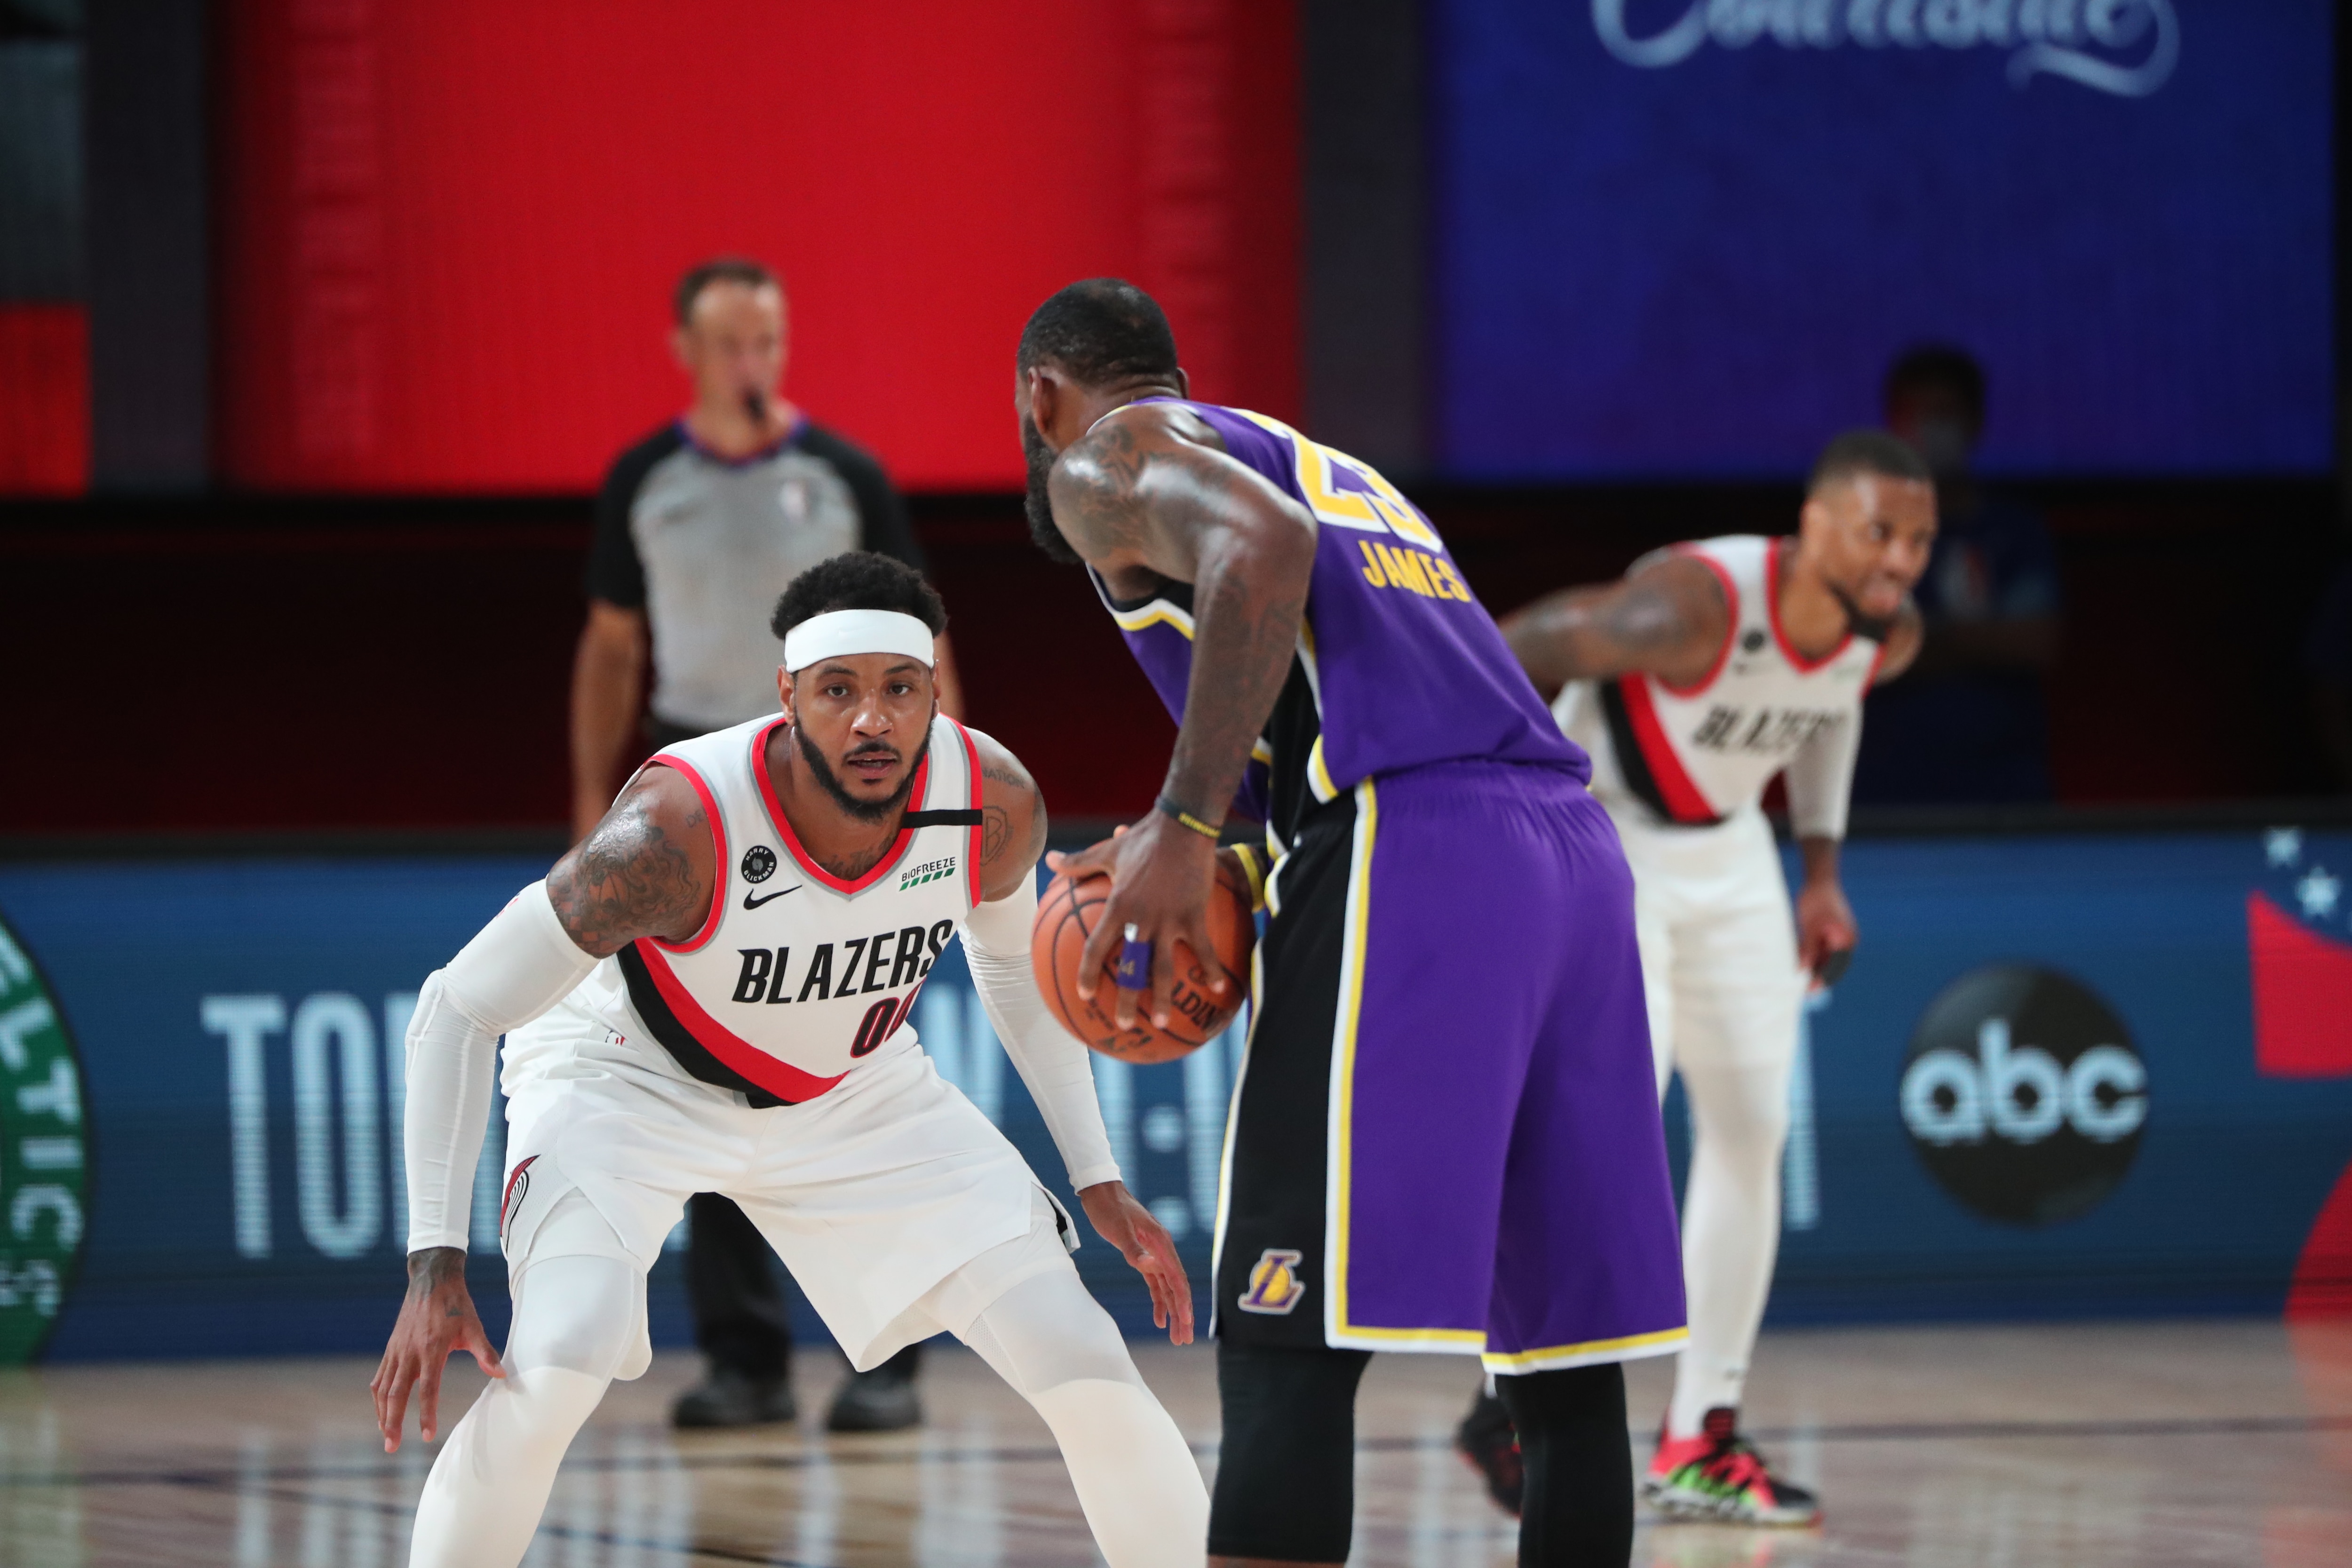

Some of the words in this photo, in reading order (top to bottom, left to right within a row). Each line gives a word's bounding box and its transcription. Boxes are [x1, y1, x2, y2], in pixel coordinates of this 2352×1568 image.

[1358, 540, 1471, 603] JAMES
[743, 861, 775, 882] GLICKMAN
[745, 848, 769, 861] HARRY
[731, 919, 954, 1004] BLAZERS
[1899, 1015, 2151, 1146] abc
